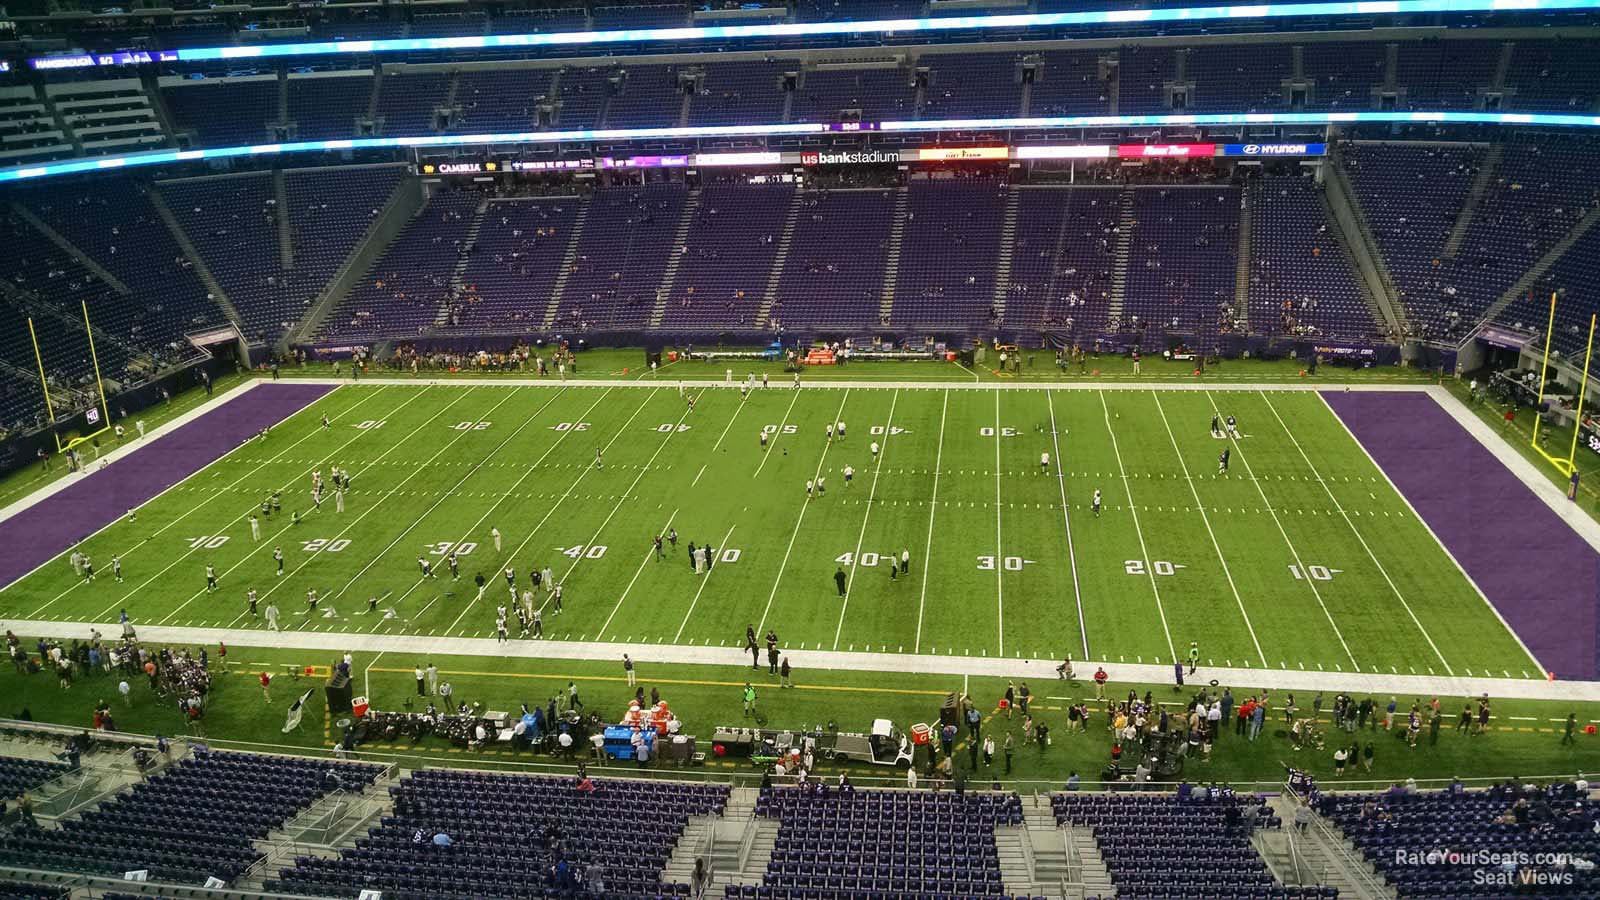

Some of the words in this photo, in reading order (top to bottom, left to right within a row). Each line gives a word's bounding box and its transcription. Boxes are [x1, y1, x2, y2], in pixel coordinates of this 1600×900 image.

[1261, 145, 1306, 154] HYUNDAI
[438, 163, 481, 173] CAMBRIA
[189, 535, 231, 549] 10
[302, 538, 352, 552] 20
[429, 541, 478, 556] 30
[563, 545, 608, 559] 40
[835, 552, 879, 567] 40
[976, 556, 1023, 571] 30
[1124, 560, 1174, 576] 20
[1288, 565, 1332, 580] 10
